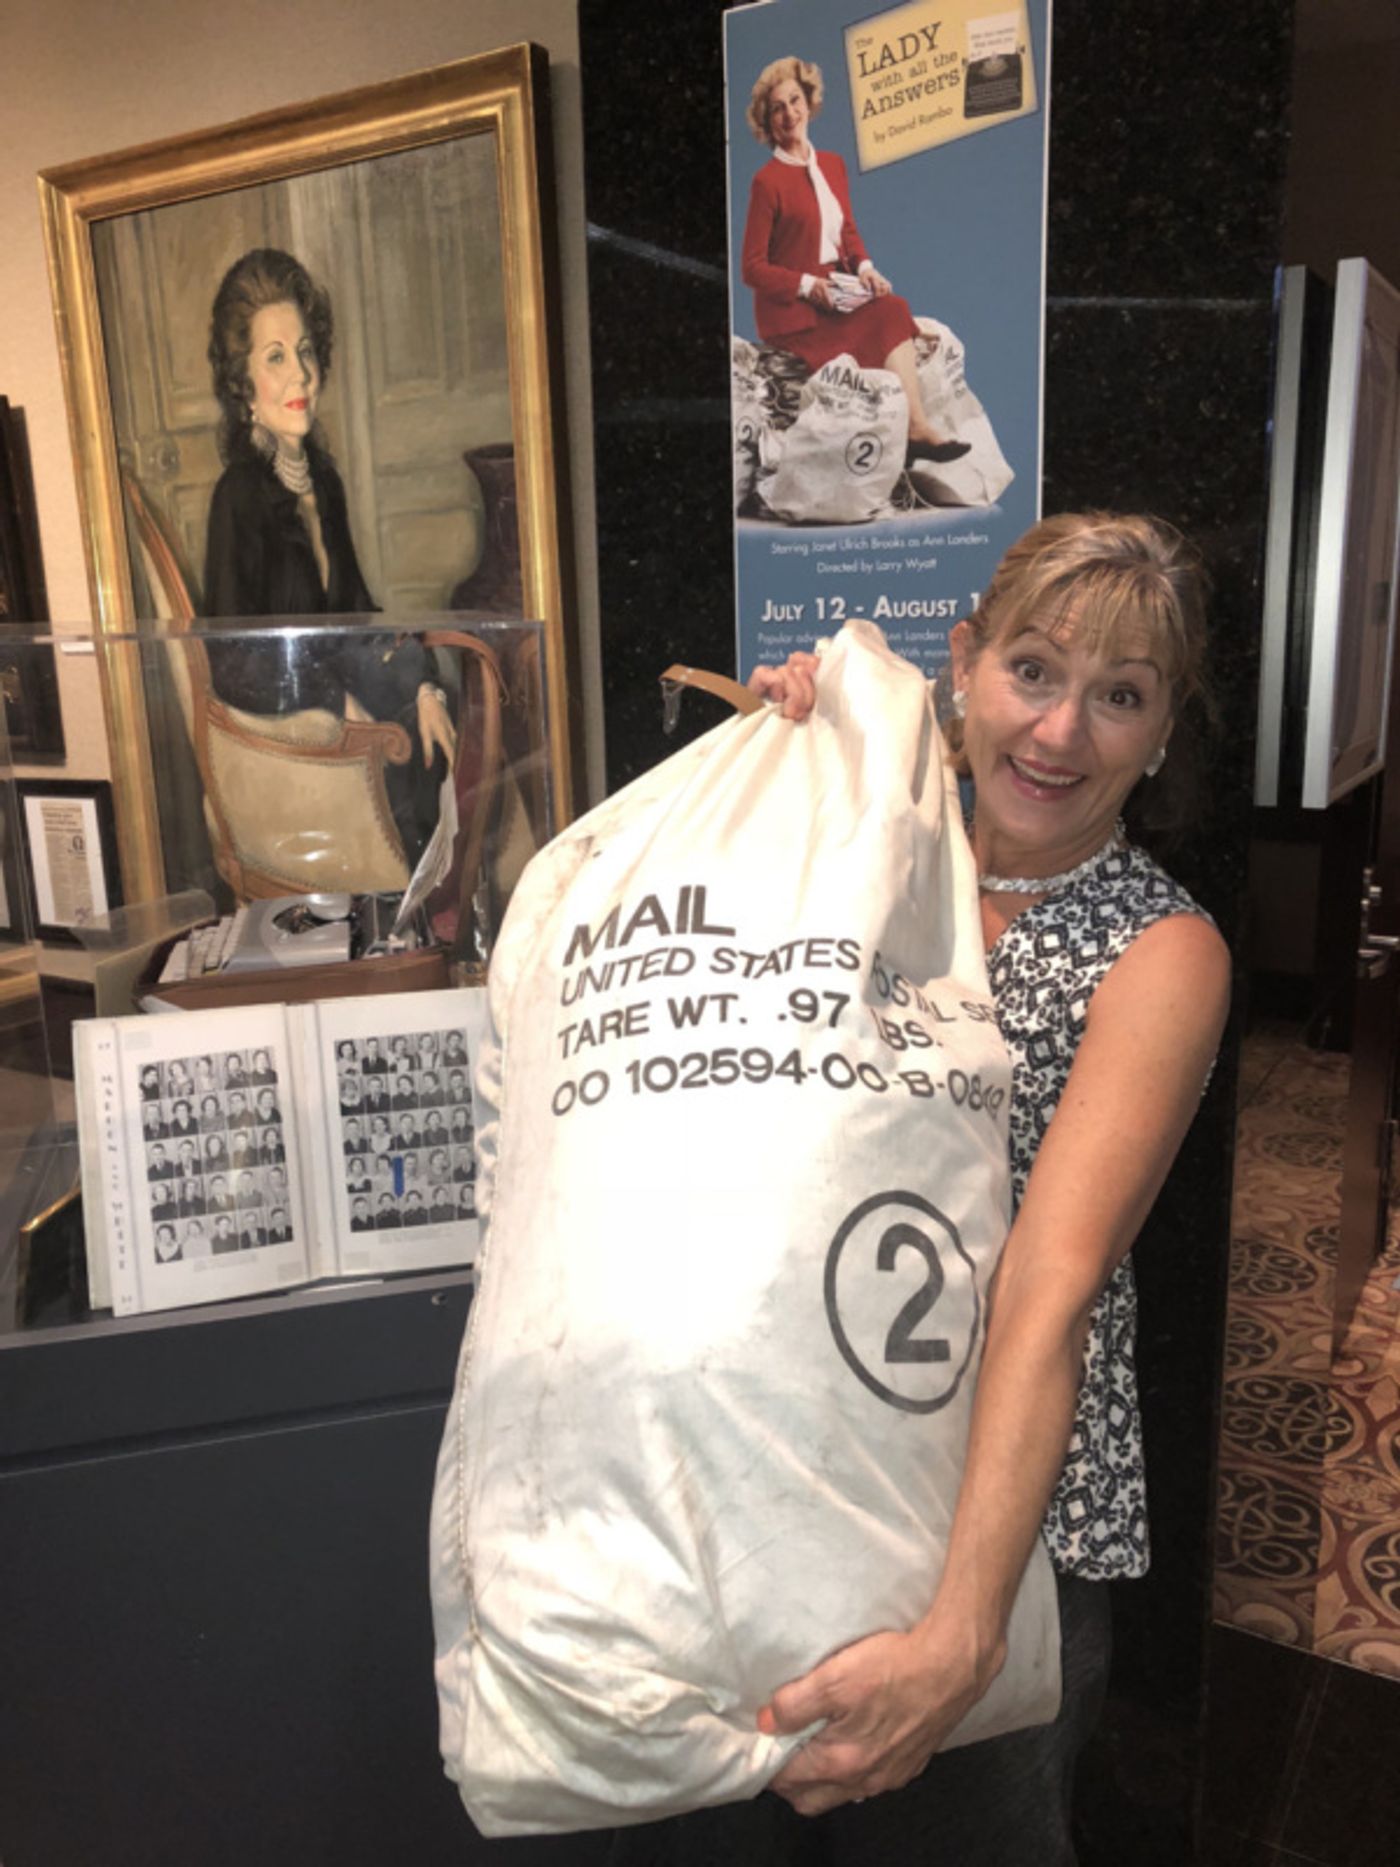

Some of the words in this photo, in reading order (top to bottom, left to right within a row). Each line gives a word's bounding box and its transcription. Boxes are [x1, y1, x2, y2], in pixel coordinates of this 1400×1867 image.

[857, 21, 942, 78] LADY
[870, 72, 904, 92] with
[909, 61, 927, 78] all
[933, 51, 958, 68] the
[862, 68, 961, 120] Answers
[873, 130, 886, 143] by
[820, 365, 870, 393] MAIL
[854, 441, 875, 467] 2
[771, 542, 809, 556] Starring
[811, 541, 837, 552] Janet
[870, 536, 905, 550] Brooks
[907, 539, 920, 547] as
[922, 535, 944, 545] Ann
[947, 532, 989, 545] Landers
[816, 561, 858, 574] Directed
[860, 560, 873, 574] by
[875, 561, 902, 573] Larry
[905, 558, 937, 571] Wyatt
[815, 596, 846, 619] 12
[563, 885, 736, 967] MAIL
[560, 946, 696, 1007] UNITED
[709, 938, 862, 980] STATES
[557, 1001, 651, 1060] TARE
[667, 993, 748, 1030] WT.
[778, 988, 851, 1028] .97
[876, 1222, 951, 1364] 2
